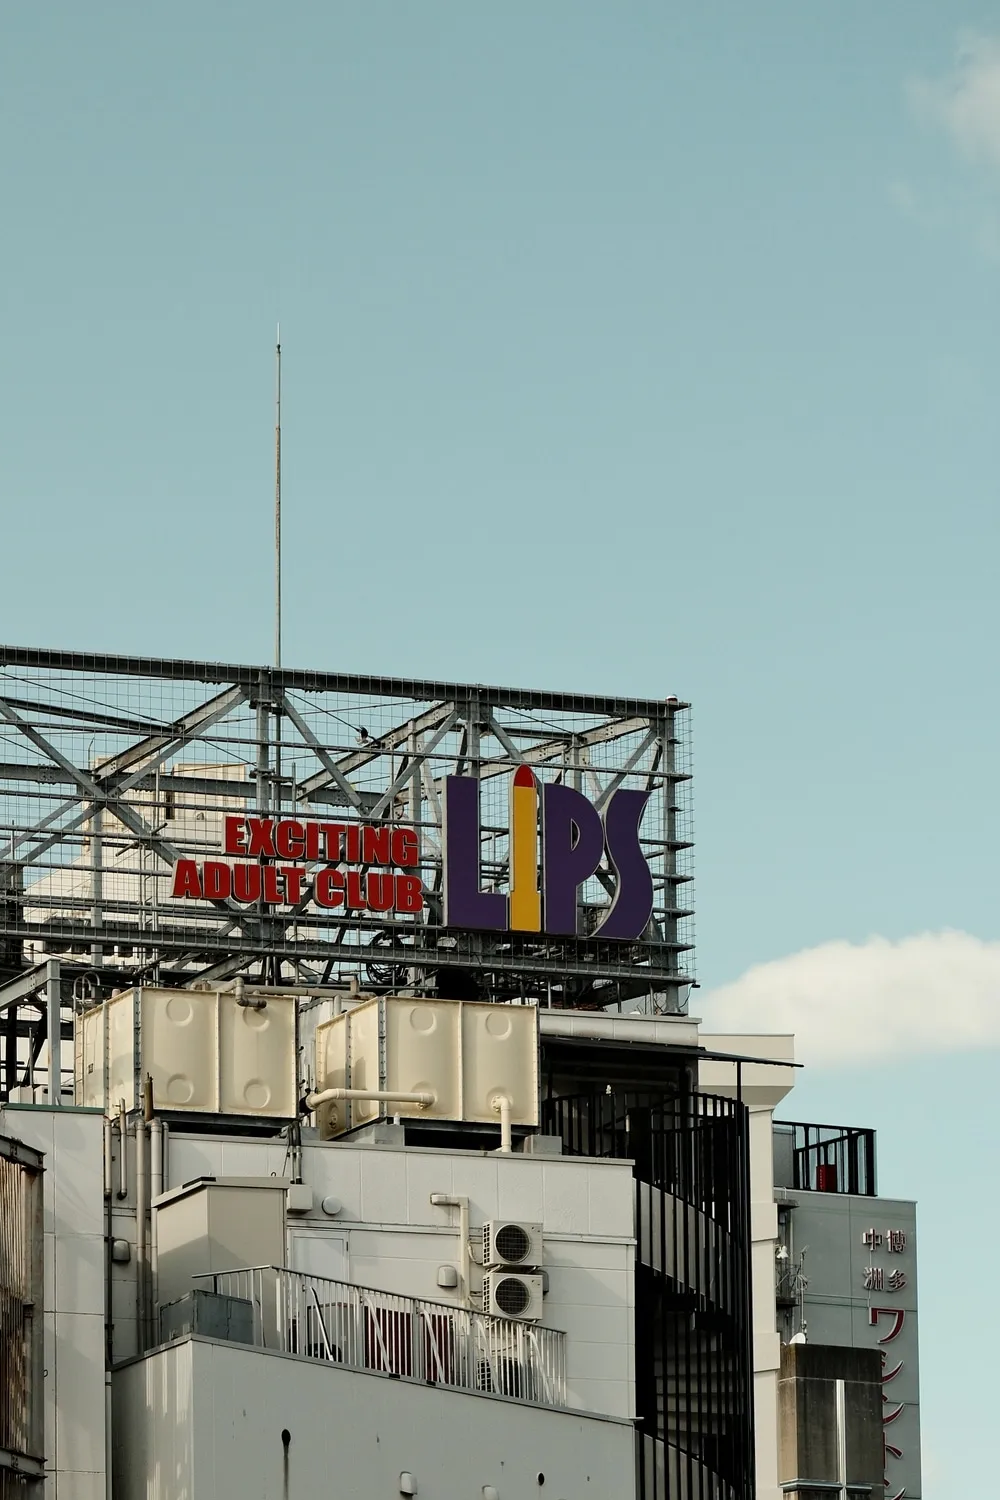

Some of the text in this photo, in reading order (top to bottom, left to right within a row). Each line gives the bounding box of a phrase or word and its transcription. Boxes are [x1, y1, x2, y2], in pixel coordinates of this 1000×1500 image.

[222, 815, 420, 868] EXCITING
[442, 763, 654, 939] LIPS
[171, 858, 424, 914] ADULT CLUB
